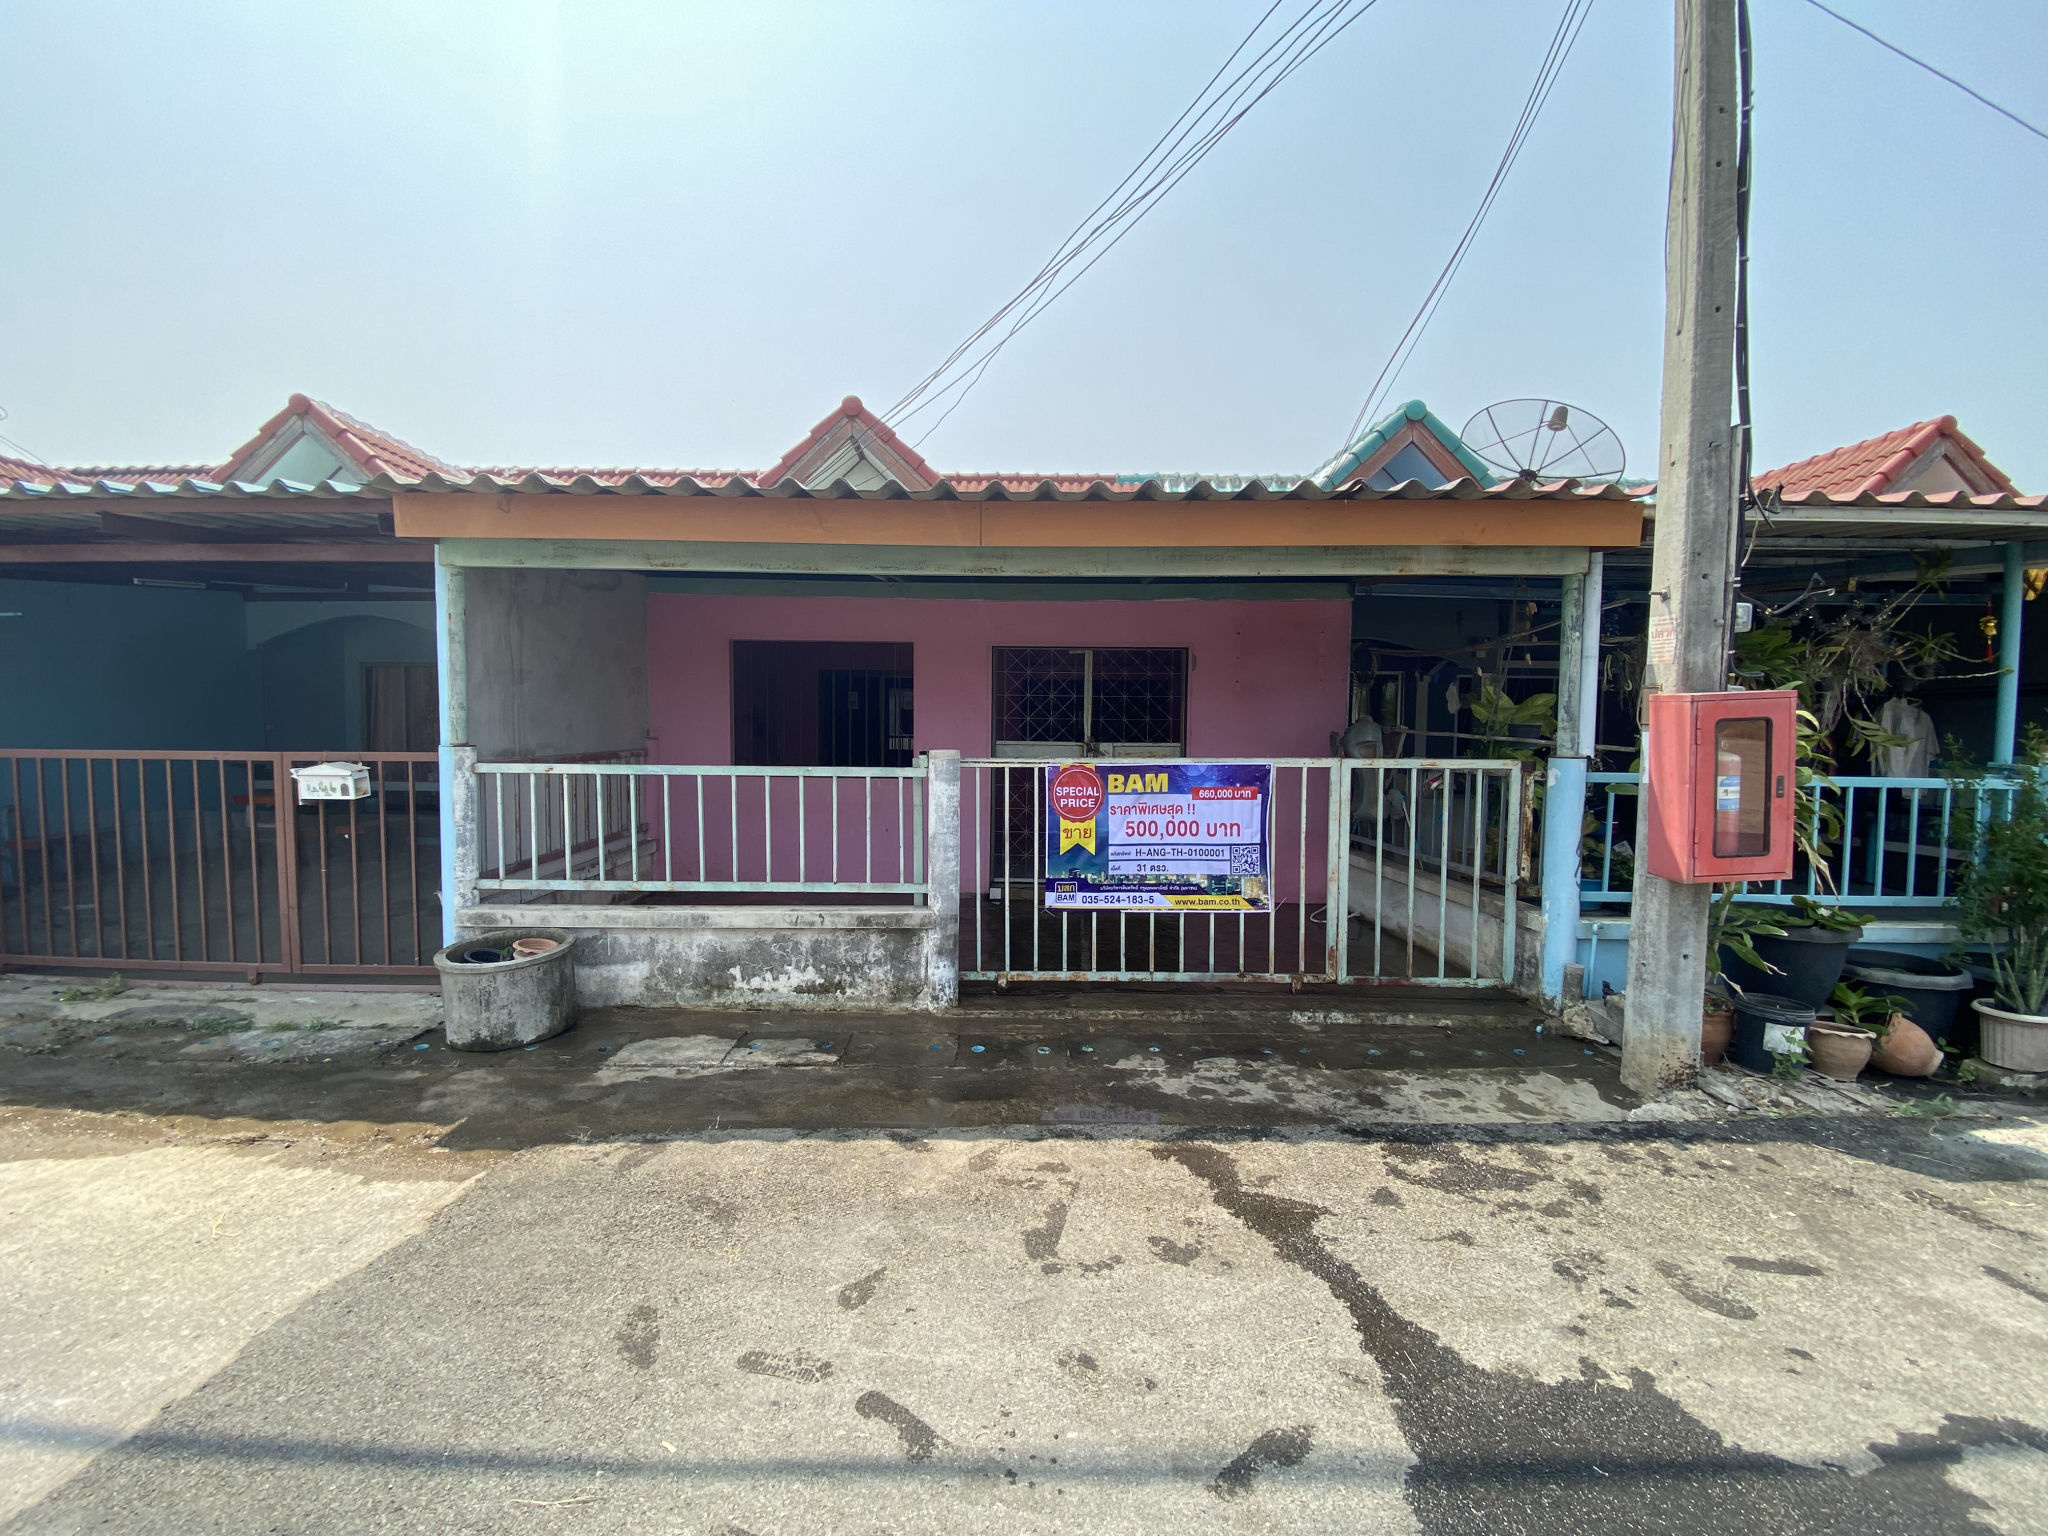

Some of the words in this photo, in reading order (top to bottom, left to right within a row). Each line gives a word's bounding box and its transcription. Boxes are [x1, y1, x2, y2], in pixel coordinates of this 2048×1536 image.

[1107, 773, 1169, 793] BAM
[1056, 786, 1100, 797] SPECIAL
[1199, 789, 1233, 799] 660,000
[1234, 790, 1252, 798] บาท
[1060, 798, 1096, 808] PRICE
[1109, 803, 1183, 819] ราคาพิเศษสุด
[1187, 803, 1196, 815] !!
[1062, 826, 1092, 840] ขาย
[1125, 820, 1200, 840] 500,000
[1206, 821, 1241, 838] บาท
[1135, 847, 1225, 858] H-ANG-TH-0100001
[1136, 864, 1147, 873] 31
[1081, 895, 1155, 905] 035-524-183-5
[1174, 898, 1241, 906] www.bam.co.th
